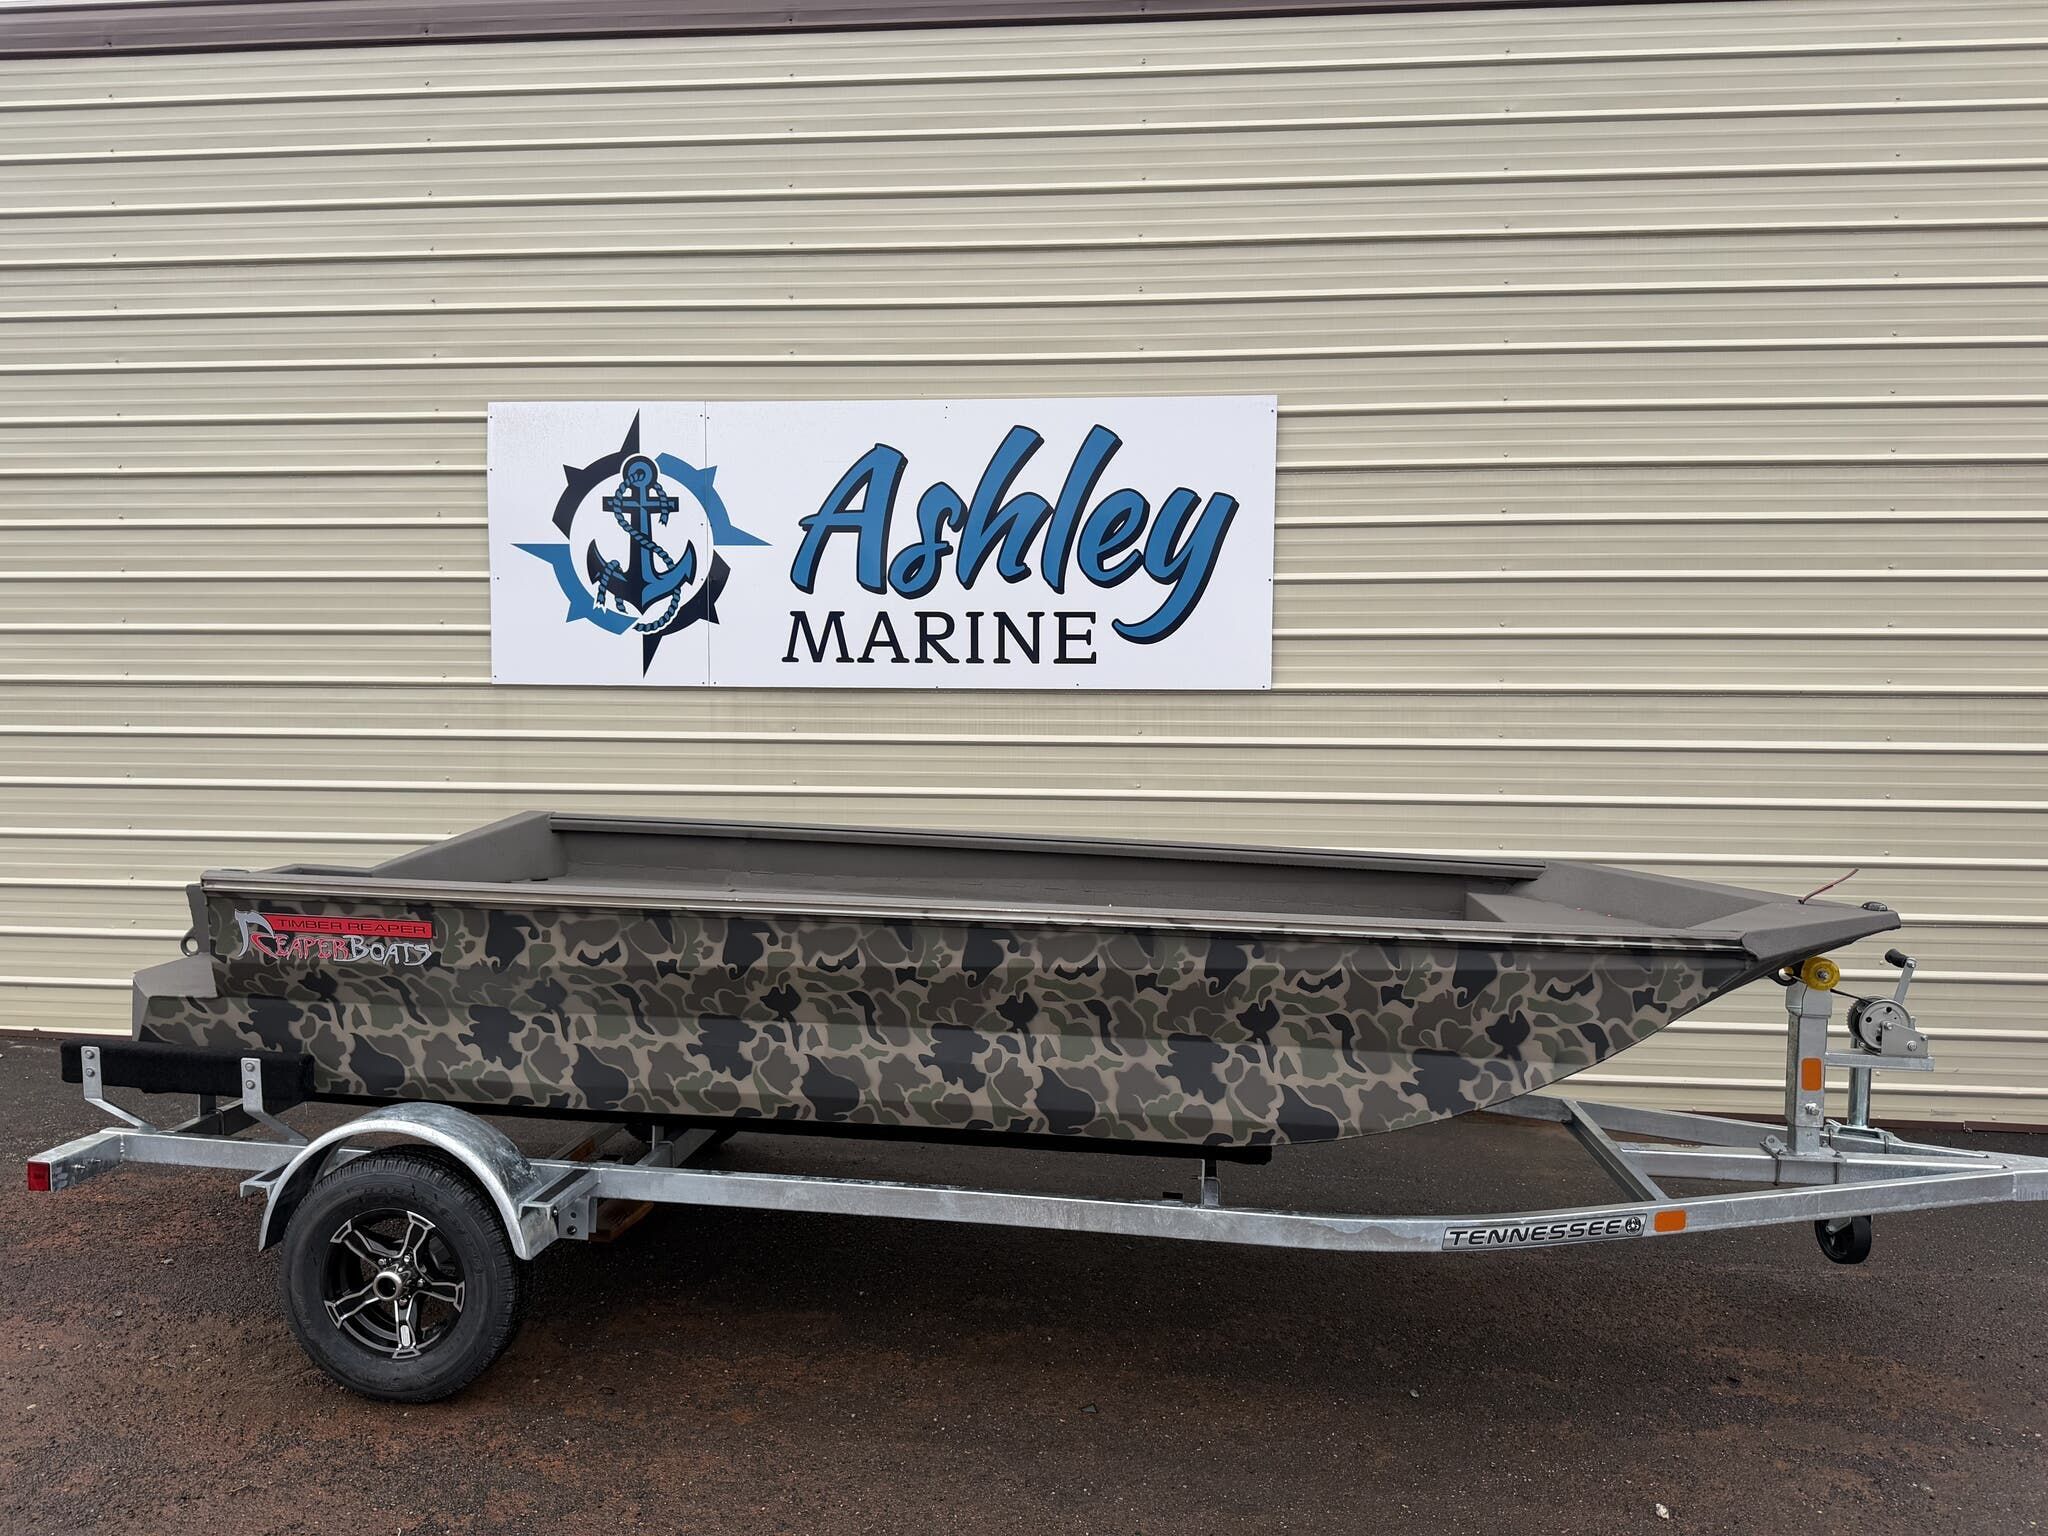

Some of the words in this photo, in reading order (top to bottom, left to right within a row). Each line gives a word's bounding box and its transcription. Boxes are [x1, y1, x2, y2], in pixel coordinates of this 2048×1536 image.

[790, 424, 1240, 644] Ashley
[781, 611, 1097, 664] MARINE
[278, 918, 342, 931] TIMBER
[349, 922, 427, 935] REAPER
[1450, 1219, 1622, 1246] TENNESSEE
